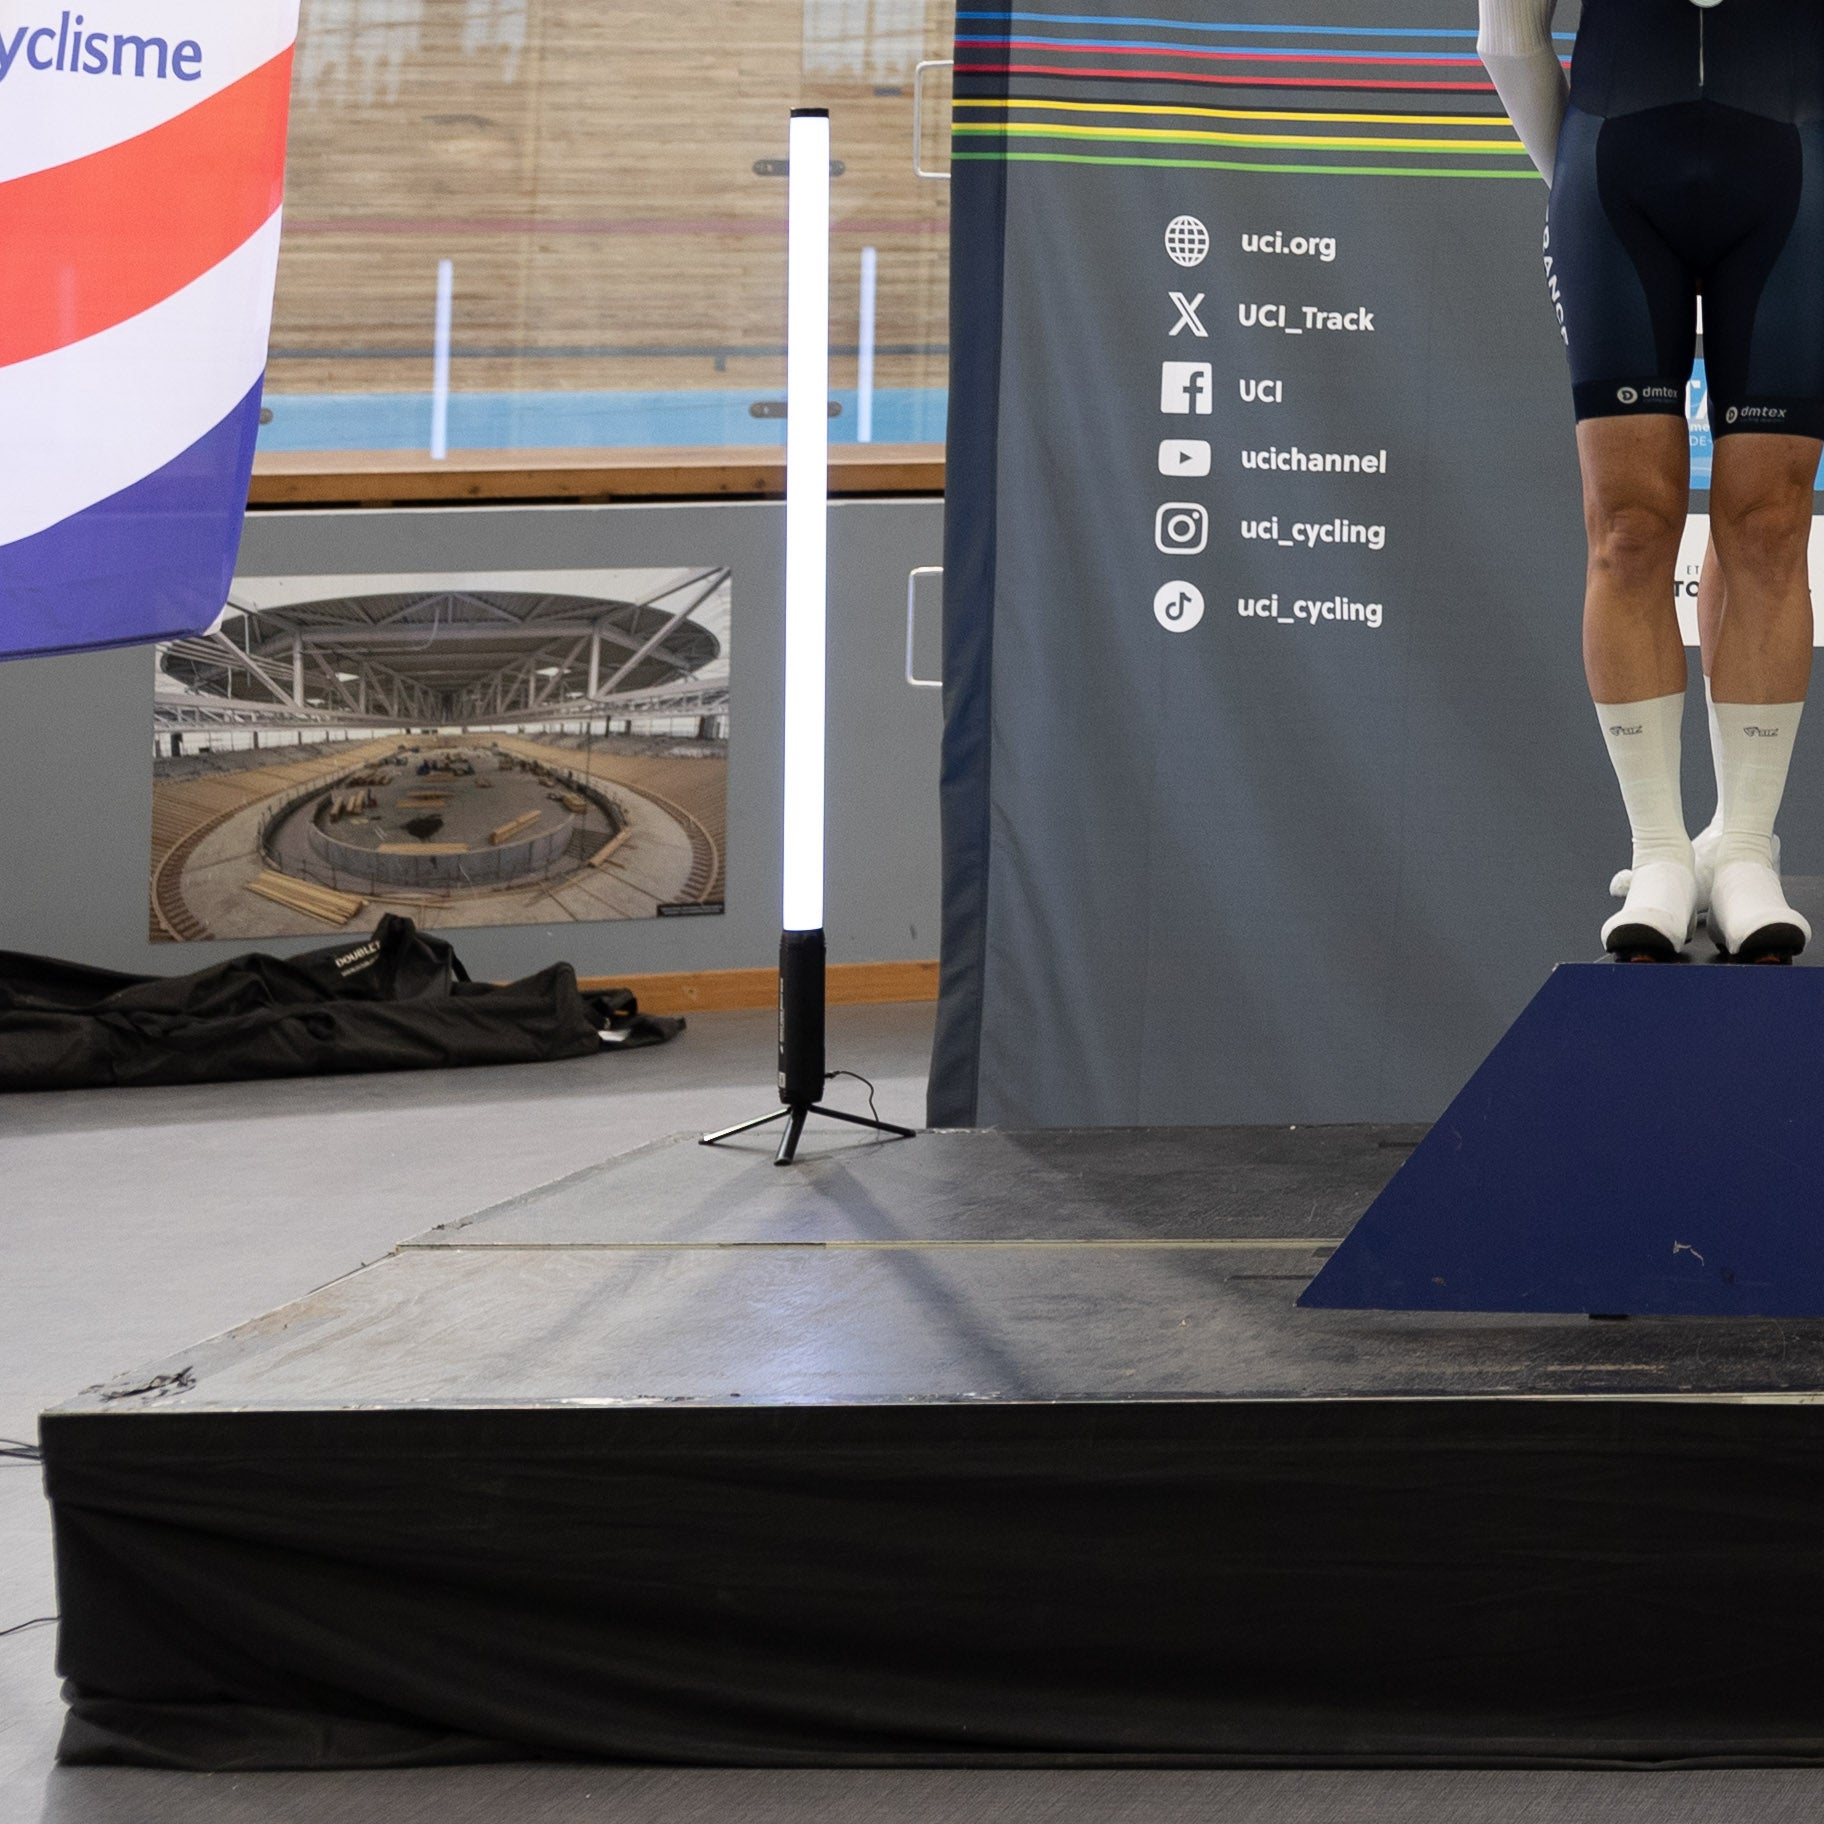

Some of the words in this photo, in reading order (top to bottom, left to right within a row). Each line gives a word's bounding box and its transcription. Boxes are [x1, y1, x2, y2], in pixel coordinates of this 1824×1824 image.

[1241, 230, 1337, 262] uci.org
[1238, 303, 1375, 334] UCI_Track
[1239, 379, 1284, 403] UCI
[1741, 405, 1787, 419] dmtex
[1241, 446, 1387, 475] ucichannel
[1241, 517, 1387, 551] uci_cycling
[1238, 595, 1384, 628] uci_cycling
